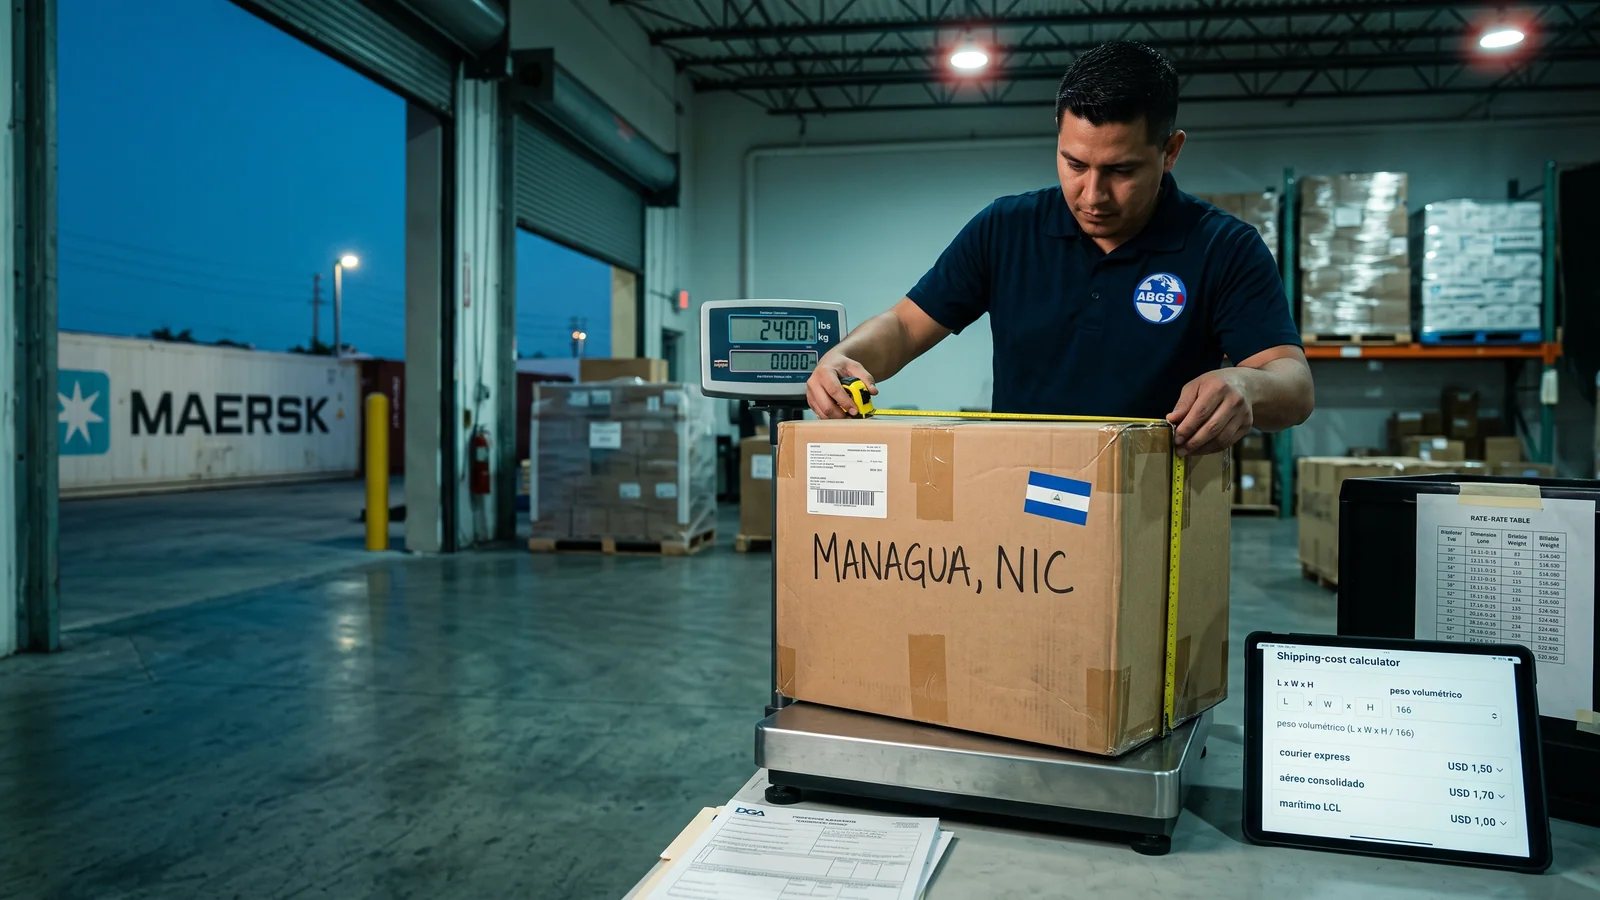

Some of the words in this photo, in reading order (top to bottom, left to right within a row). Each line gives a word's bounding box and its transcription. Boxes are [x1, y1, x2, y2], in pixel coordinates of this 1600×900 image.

[1136, 292, 1174, 304] ABGS
[760, 320, 808, 341] 240.0
[818, 322, 831, 330] lbs
[818, 333, 829, 343] kg
[771, 354, 808, 370] 0.000
[130, 390, 330, 436] MAERSK
[1470, 515, 1508, 523] RATE-RATE
[1509, 516, 1530, 524] TABLE
[814, 532, 983, 594] MANAGUA,
[996, 544, 1074, 594] NIC
[1277, 651, 1346, 664] Shipping-cost
[1350, 656, 1400, 667] calculator
[1390, 688, 1410, 696] peso
[1412, 689, 1462, 699] volumétrico
[1396, 706, 1412, 714] 166
[1277, 720, 1296, 728] peso
[1298, 721, 1345, 731] volumétrico
[1347, 724, 1355, 733] (L
[1364, 726, 1372, 734] W
[1396, 728, 1414, 738] 166)
[1280, 749, 1311, 758] courier
[1314, 752, 1350, 761] express
[1448, 762, 1468, 771] USD
[1472, 764, 1492, 774] 1,50
[1280, 774, 1305, 783] aéreo
[1308, 777, 1364, 788] consolidado
[1449, 788, 1470, 797] USD
[1473, 790, 1494, 800] 1,70
[735, 807, 765, 816] DGA
[1280, 800, 1321, 810] marítimo
[1324, 803, 1341, 812] LCL
[1451, 814, 1471, 824] USD
[1475, 817, 1496, 827] 1,00
